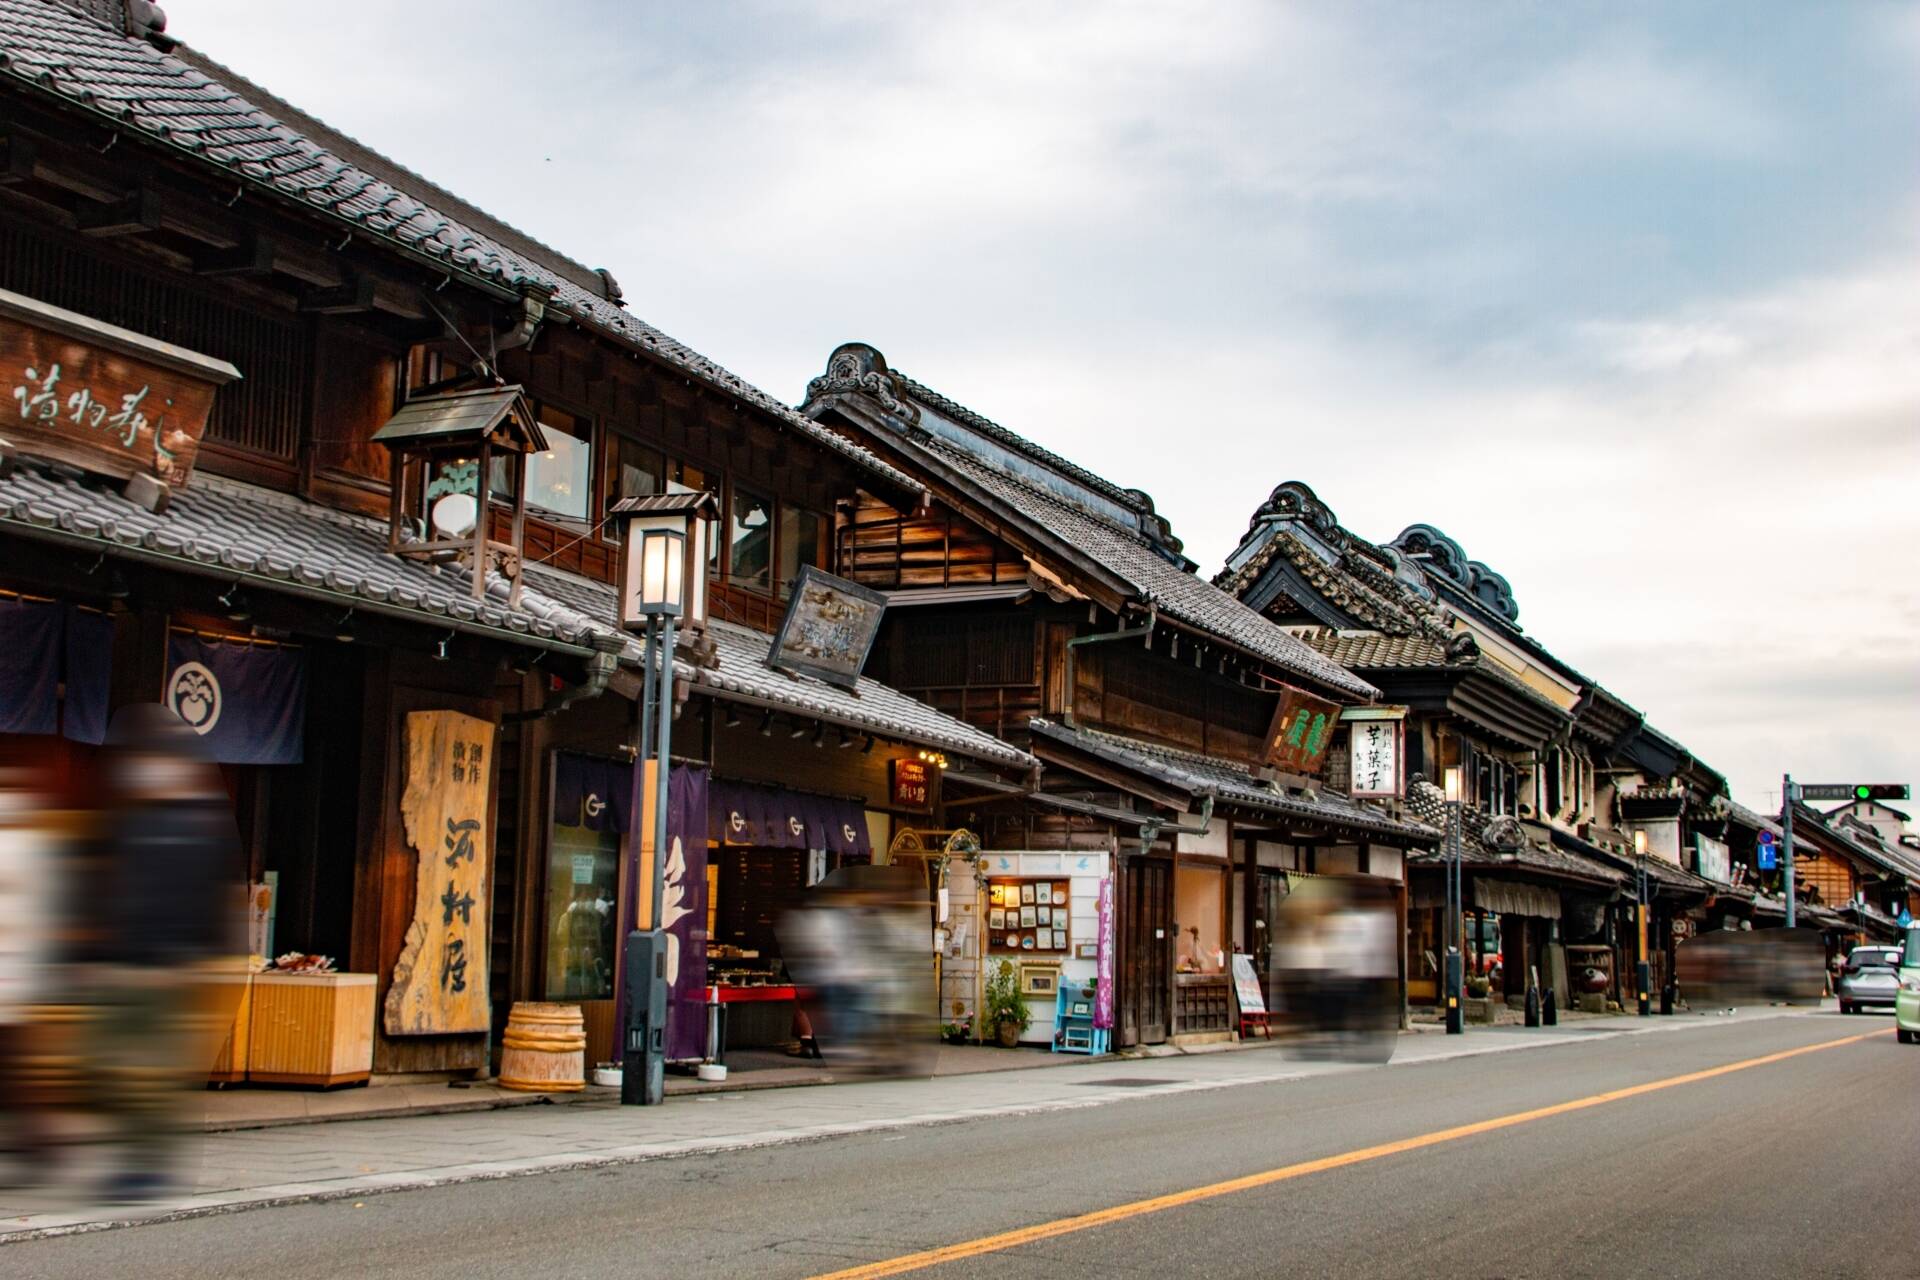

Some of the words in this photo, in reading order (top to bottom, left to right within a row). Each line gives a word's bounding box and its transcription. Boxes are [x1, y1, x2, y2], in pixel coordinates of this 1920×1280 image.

[1366, 724, 1381, 790] 芋菓子
[899, 782, 926, 803] 青い鳥
[441, 816, 481, 993] 河村屋
